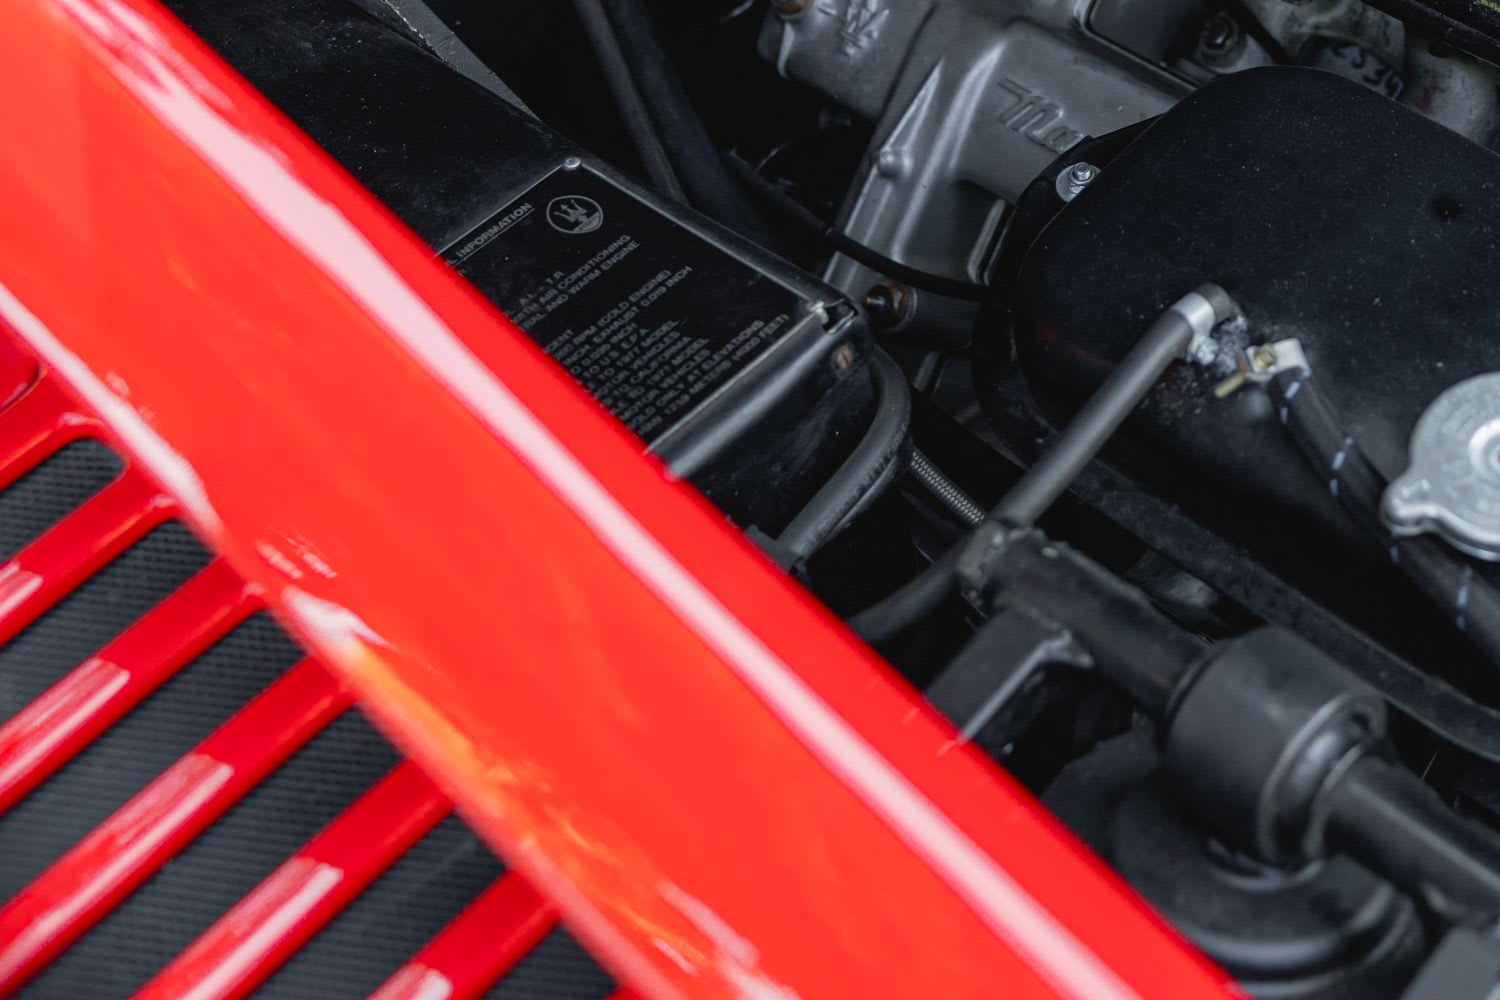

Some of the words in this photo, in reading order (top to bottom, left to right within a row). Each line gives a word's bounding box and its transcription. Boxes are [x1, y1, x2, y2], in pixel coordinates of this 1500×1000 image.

[455, 202, 532, 258] INFORMATION
[538, 288, 558, 304] AIR
[556, 234, 631, 290] CONDITIONING
[544, 293, 570, 312] AND
[566, 268, 602, 294] WARM
[600, 240, 640, 270] ENGINE
[627, 269, 672, 302] ENGINE)
[592, 306, 640, 344] EXHAUST
[664, 264, 693, 287] INCH
[628, 330, 681, 370] VEHICLES
[639, 318, 679, 348] MODEL
[670, 336, 709, 366] MODEL
[700, 318, 765, 370] ELEVATIONS
[628, 334, 692, 384] CALIFORNIA
[658, 348, 711, 389] VEHICLES
